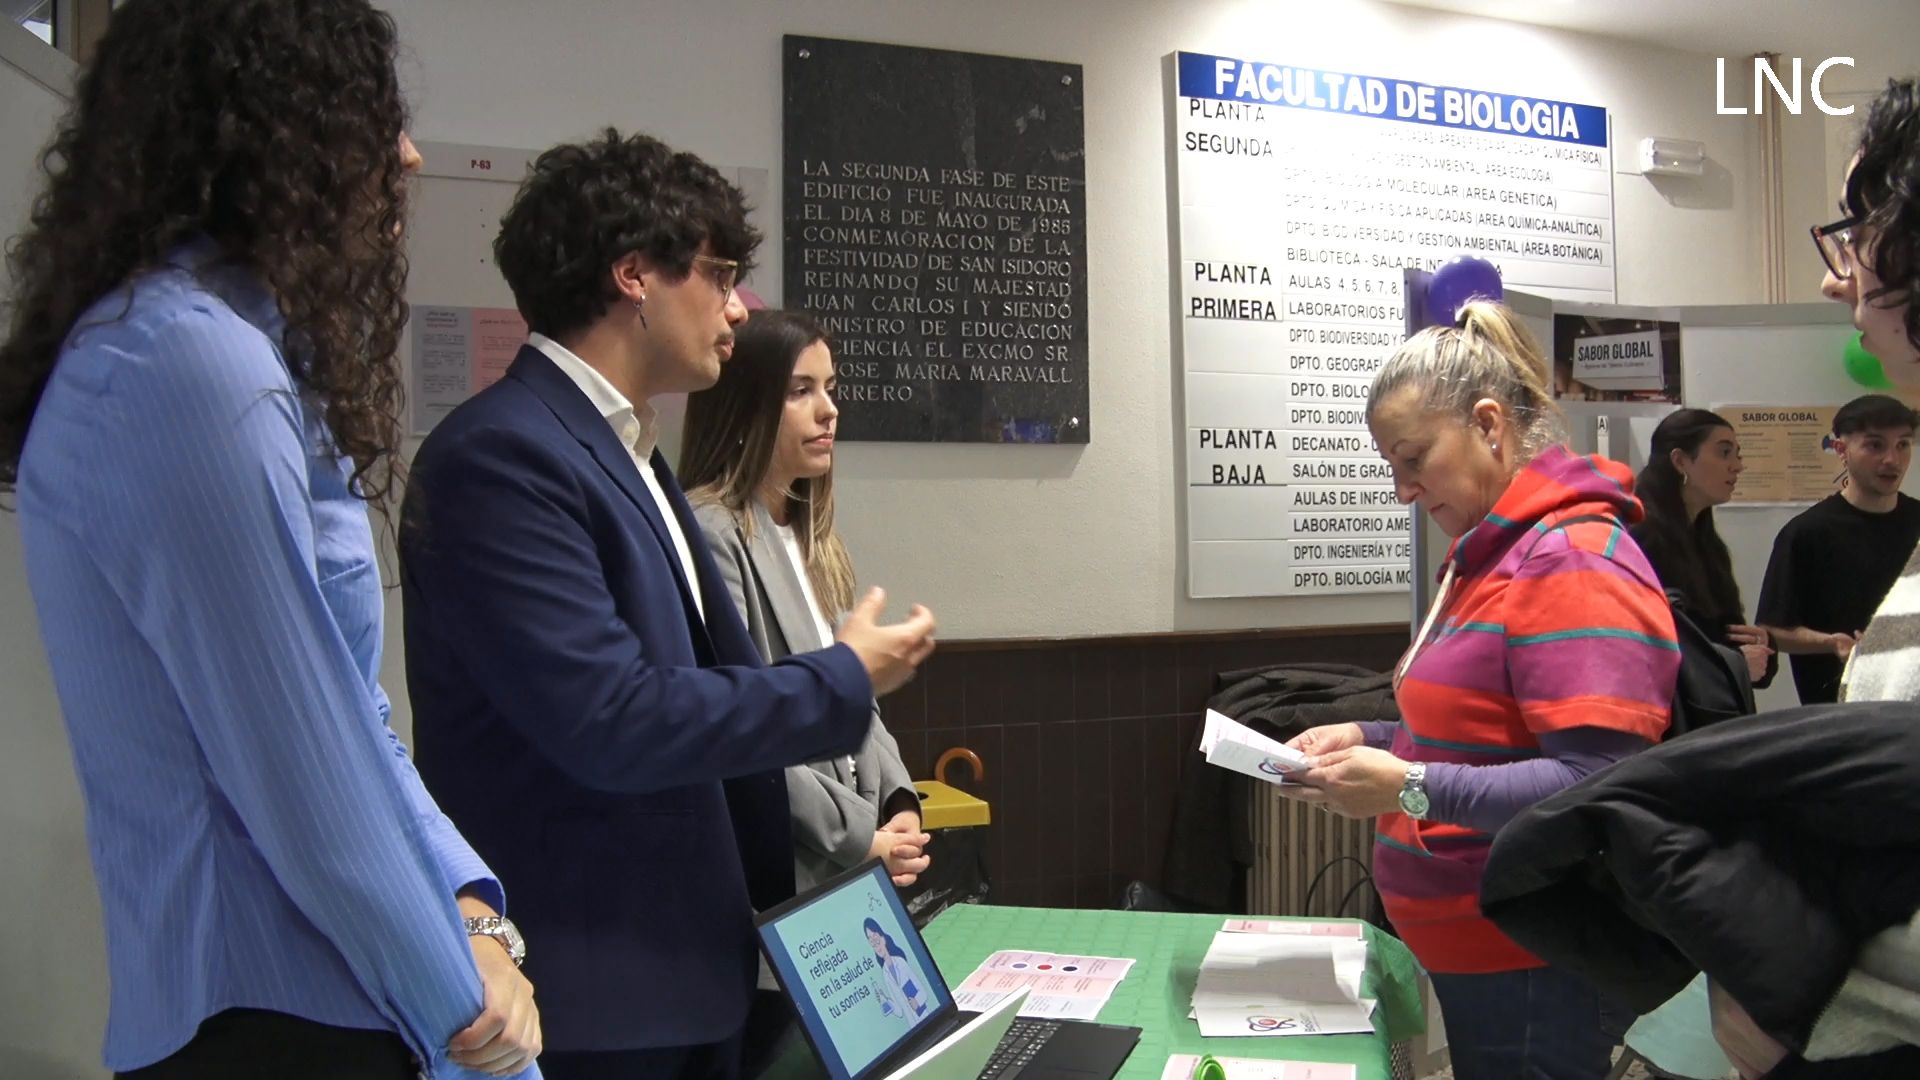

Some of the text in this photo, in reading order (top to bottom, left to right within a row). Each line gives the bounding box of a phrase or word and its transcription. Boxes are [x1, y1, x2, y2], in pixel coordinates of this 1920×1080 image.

[1190, 98, 1265, 122] PLANTA
[1215, 59, 1580, 140] FACULTAD DE BIOLOGIA
[1185, 131, 1272, 157] SEGUNDA
[803, 160, 1071, 192] LA SEGUNDA FASE DE ESTE
[803, 182, 1071, 215] EDIFICIO FUE INAUGURADA
[1387, 178, 1459, 197] MOLECULAR
[1500, 190, 1557, 211] GENETICA)
[804, 204, 1071, 235] EL DIA 8 DE MAYO DE 1985
[1416, 206, 1473, 224] APLICADAS
[803, 226, 1071, 256] CONMEMORACION DE LA
[1464, 236, 1519, 254] AMBIENTAL
[1553, 243, 1602, 264] BOTÁNICA)
[803, 248, 1072, 277] FESTIVIDAD DE SAN ISIDORO
[1287, 247, 1361, 265] BIBLIOTECA
[1372, 253, 1403, 270] SALA
[1195, 262, 1272, 285] PLANTA
[1289, 275, 1331, 290] AULAS
[803, 271, 1072, 298] REINANDO SU MAJESTAD
[803, 295, 856, 312] JUAN
[871, 297, 955, 315] CARLOS
[981, 300, 991, 316] Y
[1002, 302, 1072, 319] SIENDO
[1192, 297, 1276, 320] PRIMERA
[1289, 302, 1386, 320] LABORATORIOS
[921, 320, 947, 336] DE
[961, 322, 1072, 341] EDUCACION
[1320, 330, 1389, 346] BIODIVERSIDAD
[1391, 333, 1397, 346] Y
[925, 342, 952, 358] EL
[962, 343, 1034, 361] EXCMO
[1578, 341, 1653, 361] SABOR GLOBAL
[895, 363, 961, 381] MARIA
[969, 365, 1073, 384] MARAVALL
[1290, 356, 1323, 370] DPTO.
[837, 385, 912, 401] RRERO
[1291, 382, 1328, 398] DPTO.
[1291, 410, 1325, 424] DPTO.
[1742, 412, 1818, 422] SABOR GLOBAL
[1200, 430, 1276, 449] PLANTA
[1293, 437, 1361, 452] DECANATO
[1213, 464, 1266, 484] BAJA
[1293, 461, 1336, 478] SALÓN
[1340, 464, 1356, 478] DE
[1294, 491, 1337, 505] AULAS
[1341, 491, 1357, 505] DE
[1294, 518, 1383, 532] LABORATORIO
[1294, 545, 1325, 560] DPTO.
[1328, 540, 1385, 559] INGENIERÍA
[1386, 544, 1393, 558] Y
[1294, 573, 1331, 588] DPTO.
[1335, 567, 1393, 586] BIOLOGÍA
[799, 931, 834, 960] Ciencia
[809, 948, 849, 980] reflejada
[820, 956, 875, 1000] en la salud de
[828, 985, 871, 1019] tu sonrisa
